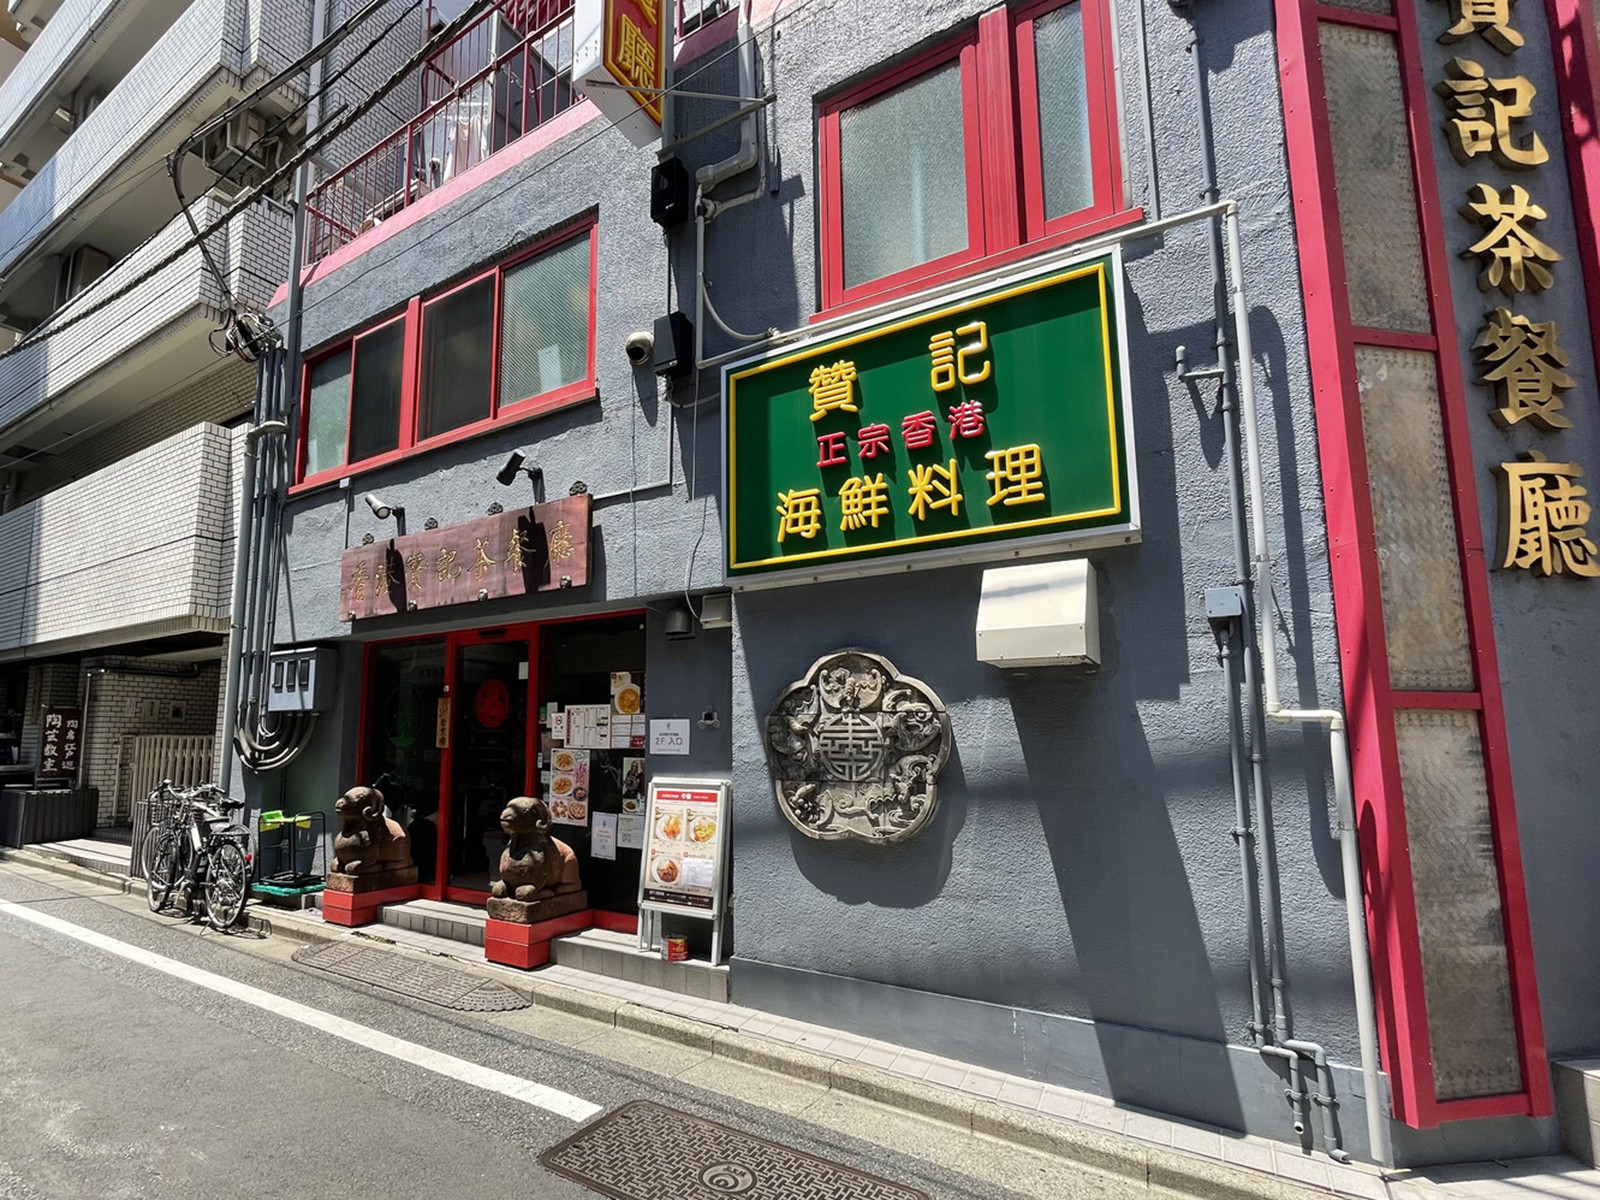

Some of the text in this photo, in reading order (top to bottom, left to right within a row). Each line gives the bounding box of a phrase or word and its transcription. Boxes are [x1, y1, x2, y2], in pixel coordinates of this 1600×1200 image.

[816, 400, 985, 468] 正宗香港
[776, 443, 1046, 543] 海鮮料理
[668, 737, 683, 746] 入口
